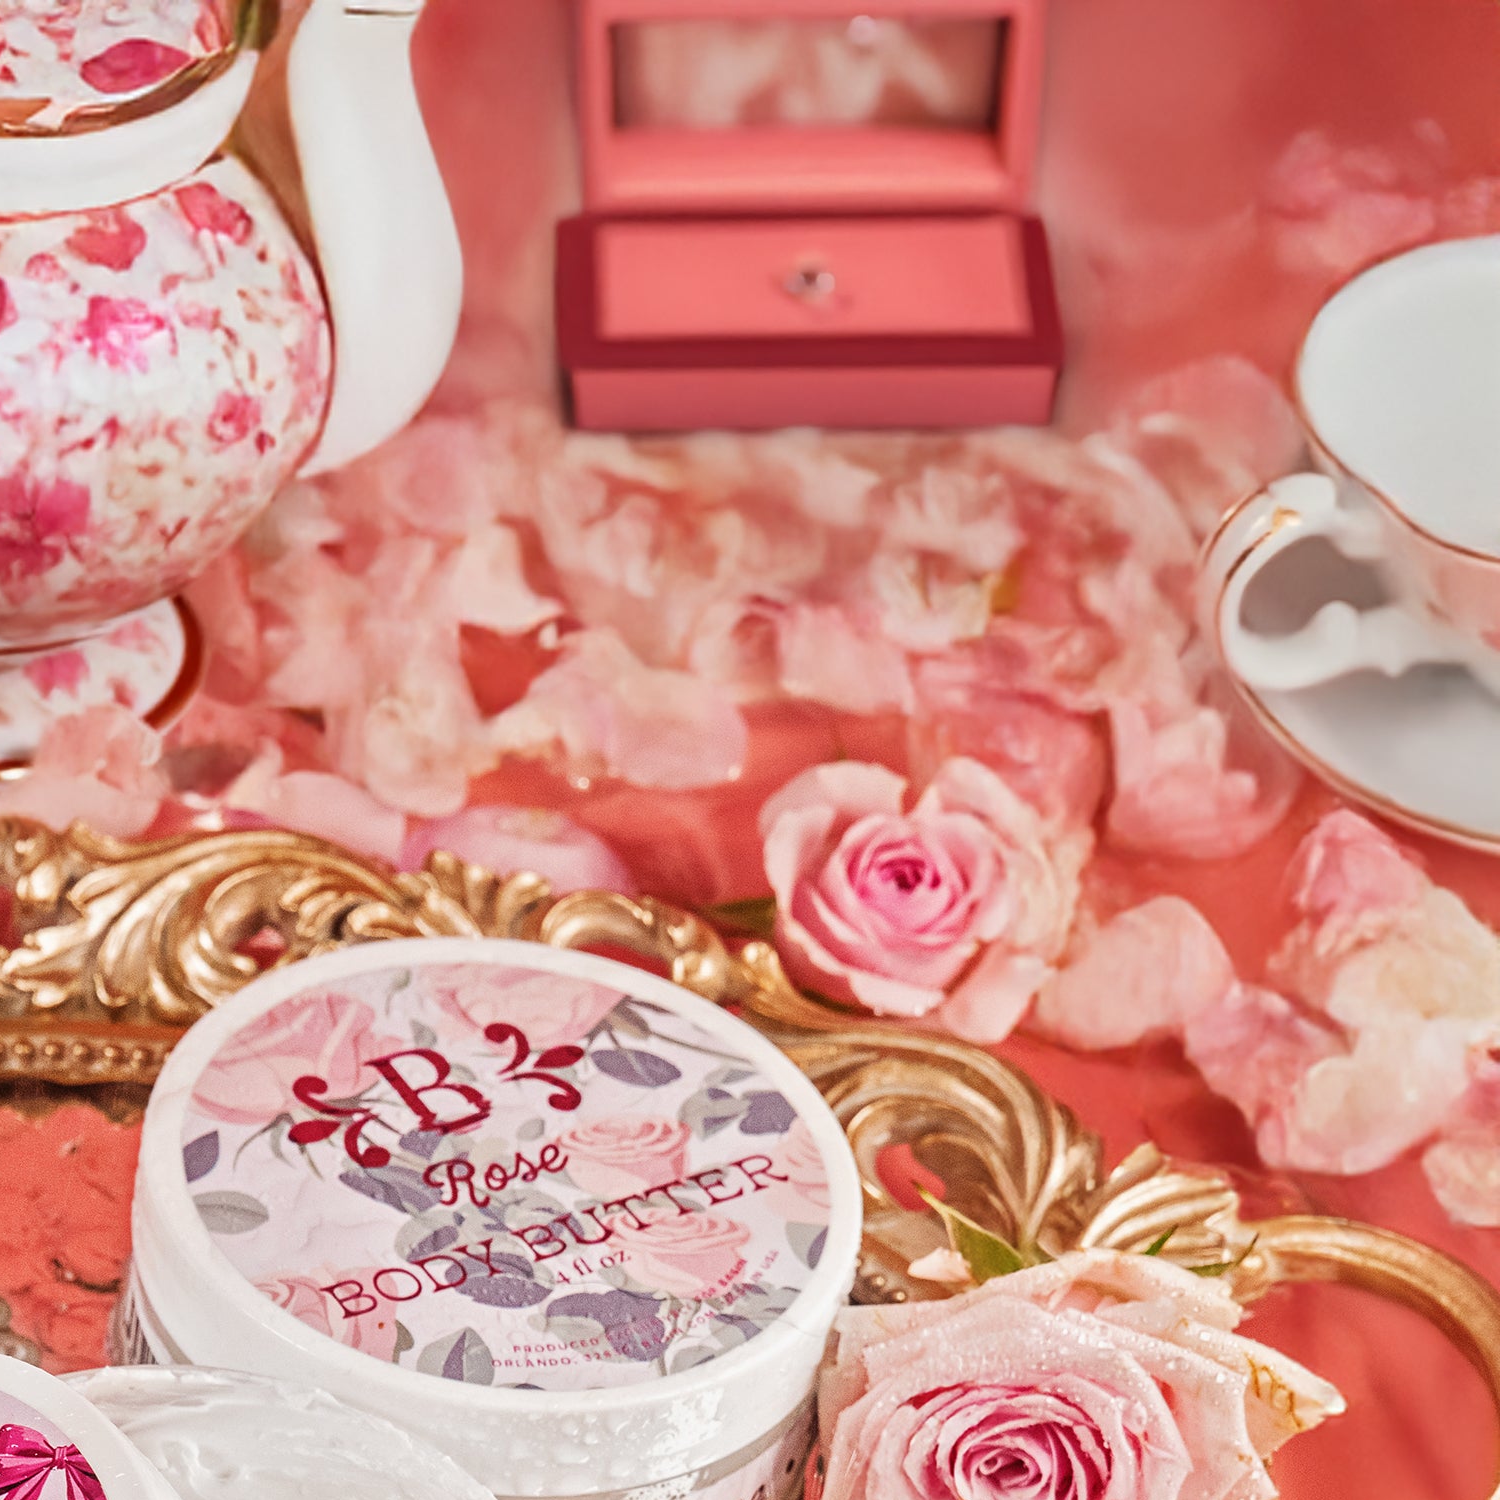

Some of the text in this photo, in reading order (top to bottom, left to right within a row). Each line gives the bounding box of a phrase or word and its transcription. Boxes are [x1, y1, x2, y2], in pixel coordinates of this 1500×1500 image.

[367, 1048, 493, 1137] B
[422, 1142, 569, 1208] Rose
[320, 1153, 790, 1319] BODY BUTTER
[556, 1270, 571, 1285] 4
[600, 1250, 632, 1269] oz
